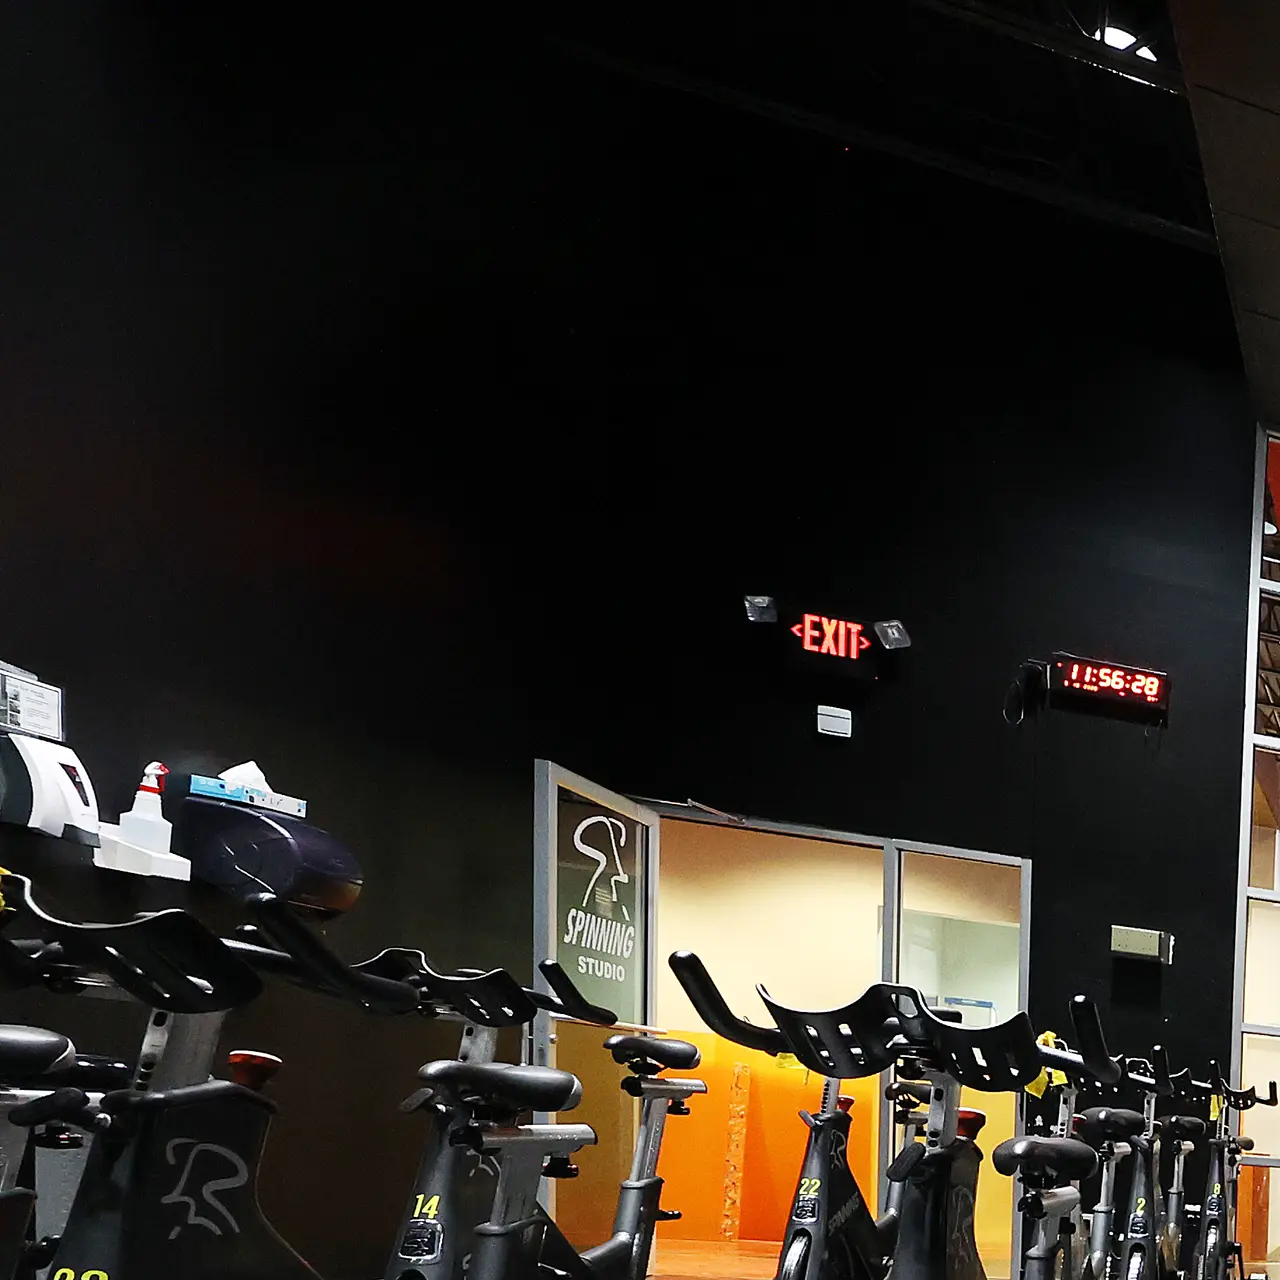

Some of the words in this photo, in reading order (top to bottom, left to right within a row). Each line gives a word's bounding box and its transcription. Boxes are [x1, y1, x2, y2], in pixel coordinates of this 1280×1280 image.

[802, 612, 863, 660] EXIT
[1069, 664, 1160, 697] 11:56:28
[563, 908, 635, 959] SPINNING
[577, 955, 626, 982] STUDIO
[798, 1177, 822, 1196] 22
[413, 1193, 441, 1220] 14
[1136, 1197, 1147, 1214] 2
